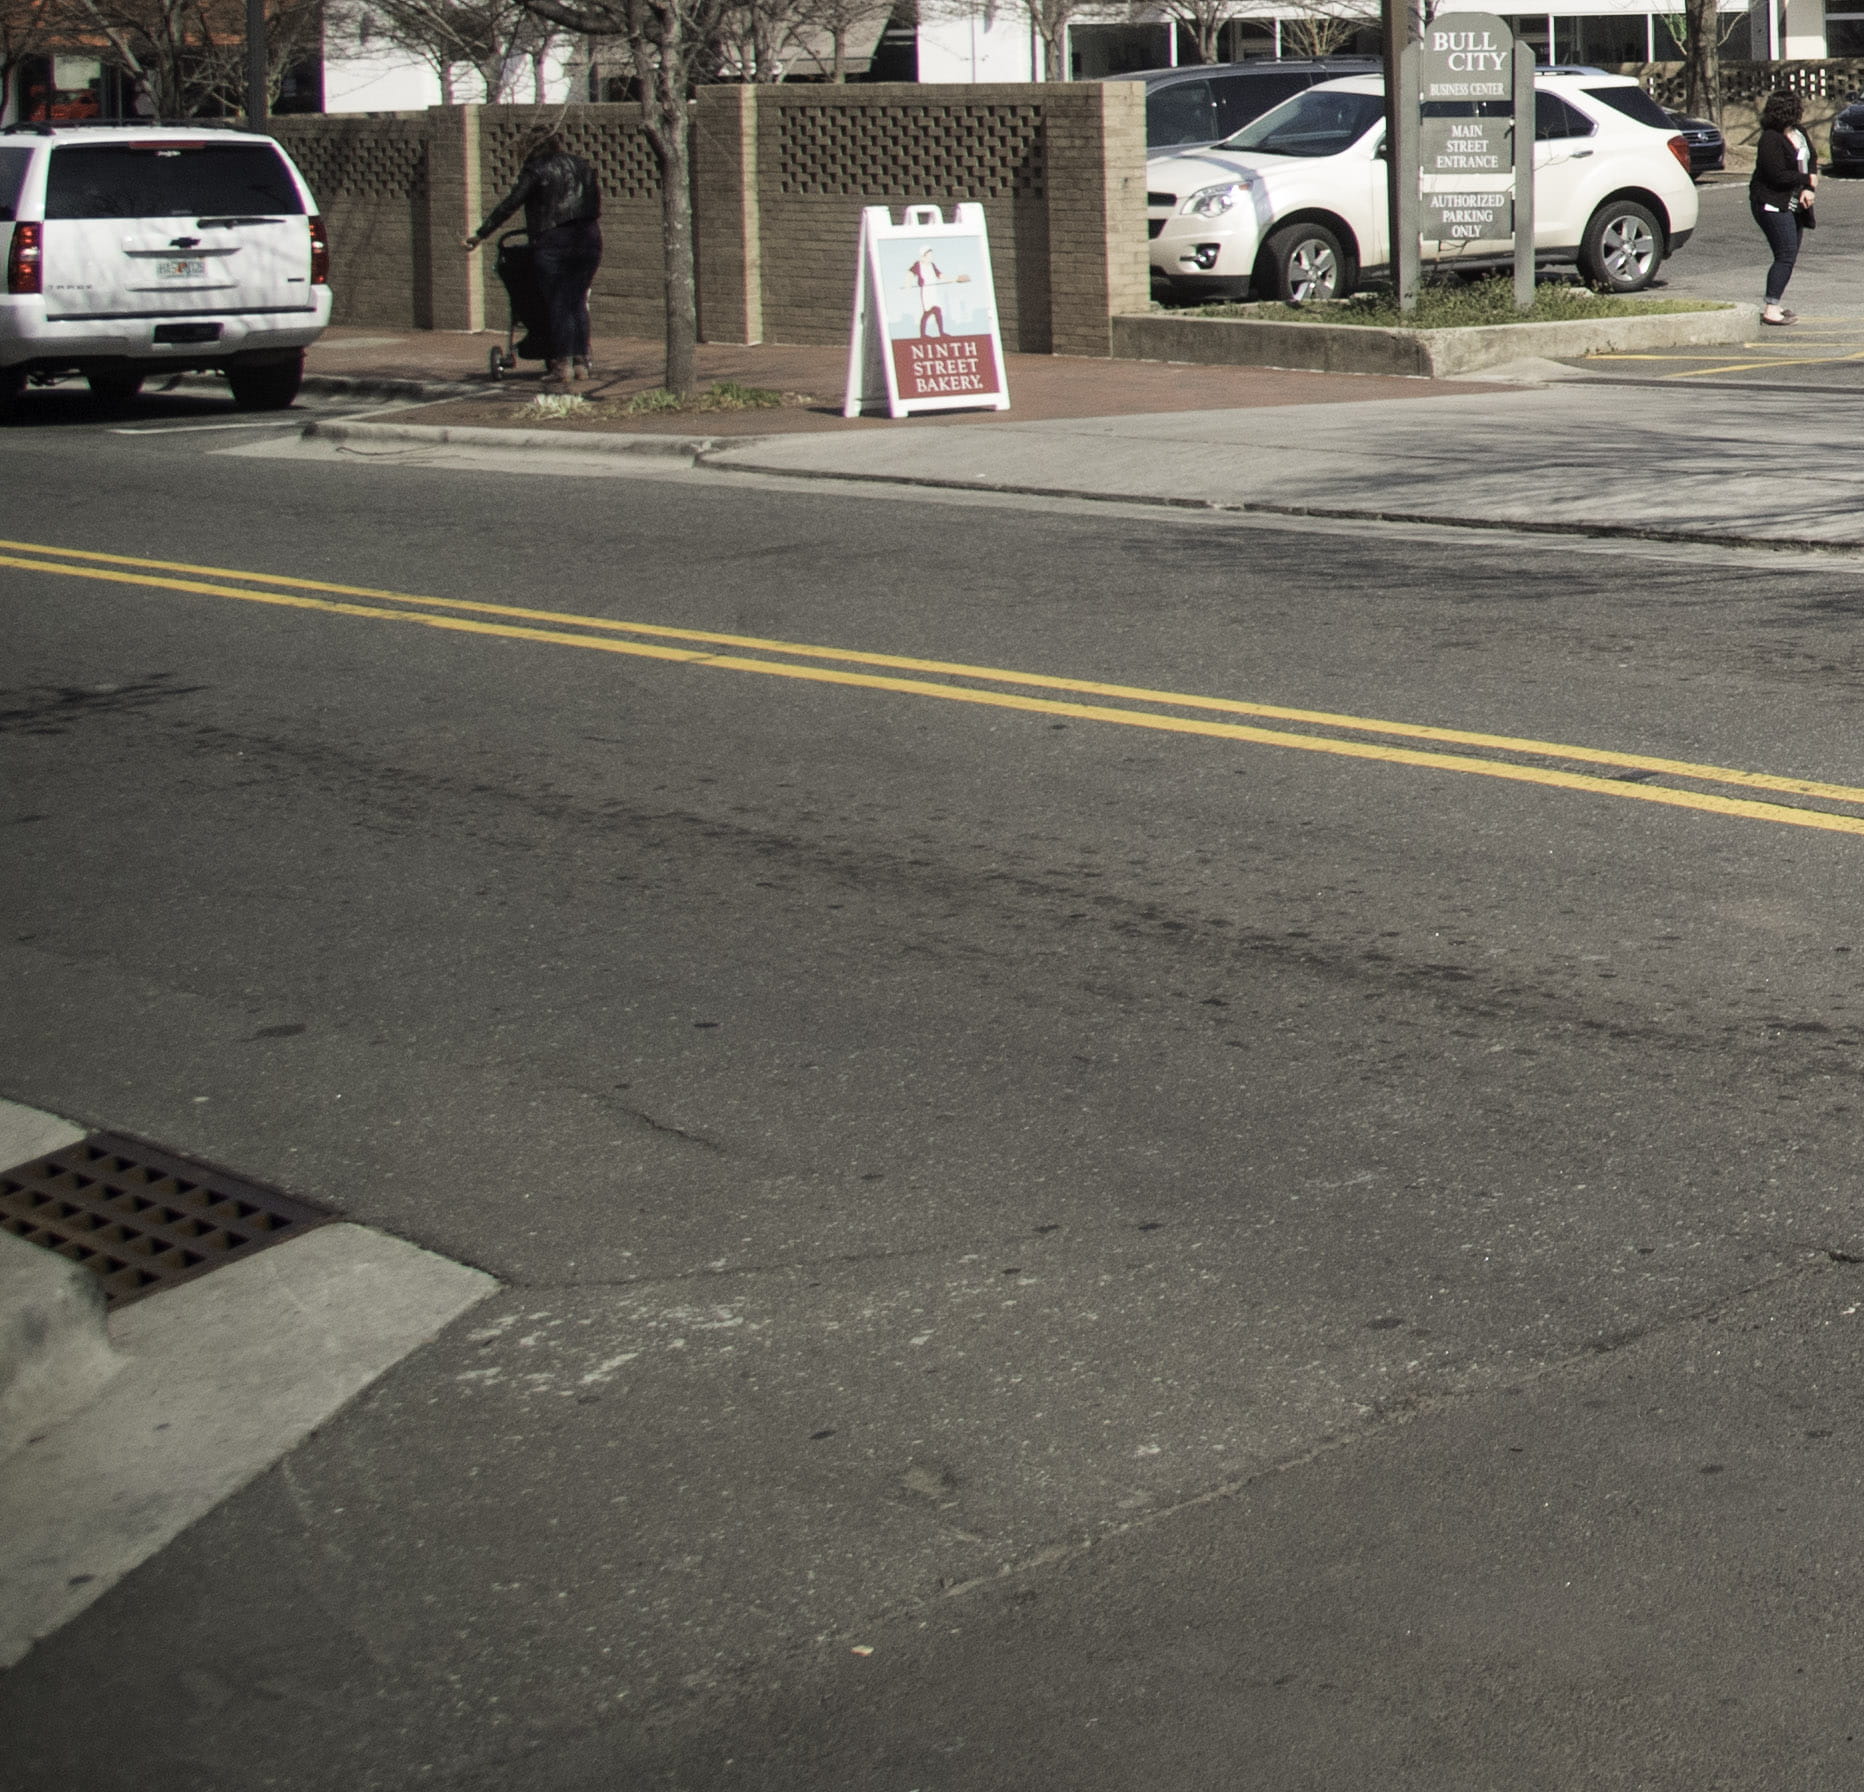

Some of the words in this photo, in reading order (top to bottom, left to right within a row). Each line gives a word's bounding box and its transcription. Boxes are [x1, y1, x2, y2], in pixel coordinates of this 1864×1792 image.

[1433, 32, 1497, 51] BULL
[1448, 52, 1508, 71] CITY
[1430, 83, 1469, 96] BUSINESS
[1470, 83, 1504, 96] CENTER
[1451, 125, 1483, 137] MAIN
[1446, 140, 1489, 152] STREET
[1437, 156, 1499, 168] ENTRANCE
[1430, 194, 1505, 208] AUTHORIZED
[1442, 210, 1494, 223] PARKING
[1451, 225, 1482, 238] ONLY
[911, 341, 978, 360] NINTH
[913, 358, 979, 377] STREET
